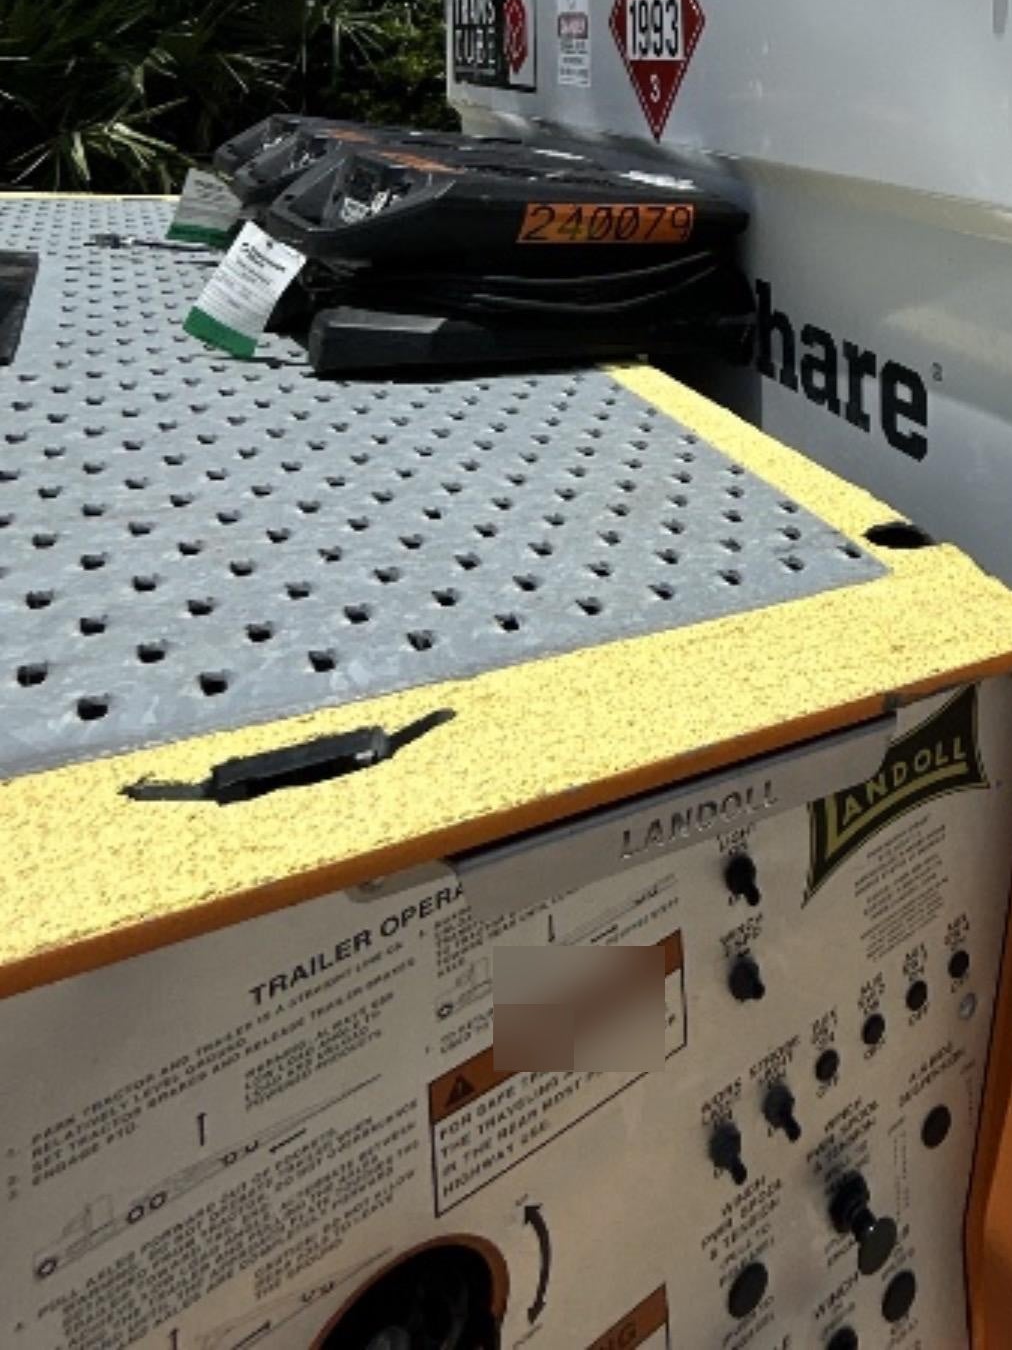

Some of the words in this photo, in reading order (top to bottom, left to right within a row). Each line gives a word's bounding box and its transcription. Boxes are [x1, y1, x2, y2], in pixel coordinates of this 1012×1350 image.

[650, 73, 662, 103] 3
[521, 205, 692, 241] 240079
[620, 778, 780, 859] LANDOLL
[825, 735, 968, 862] LANDOLL
[248, 929, 372, 1006] TRAILER
